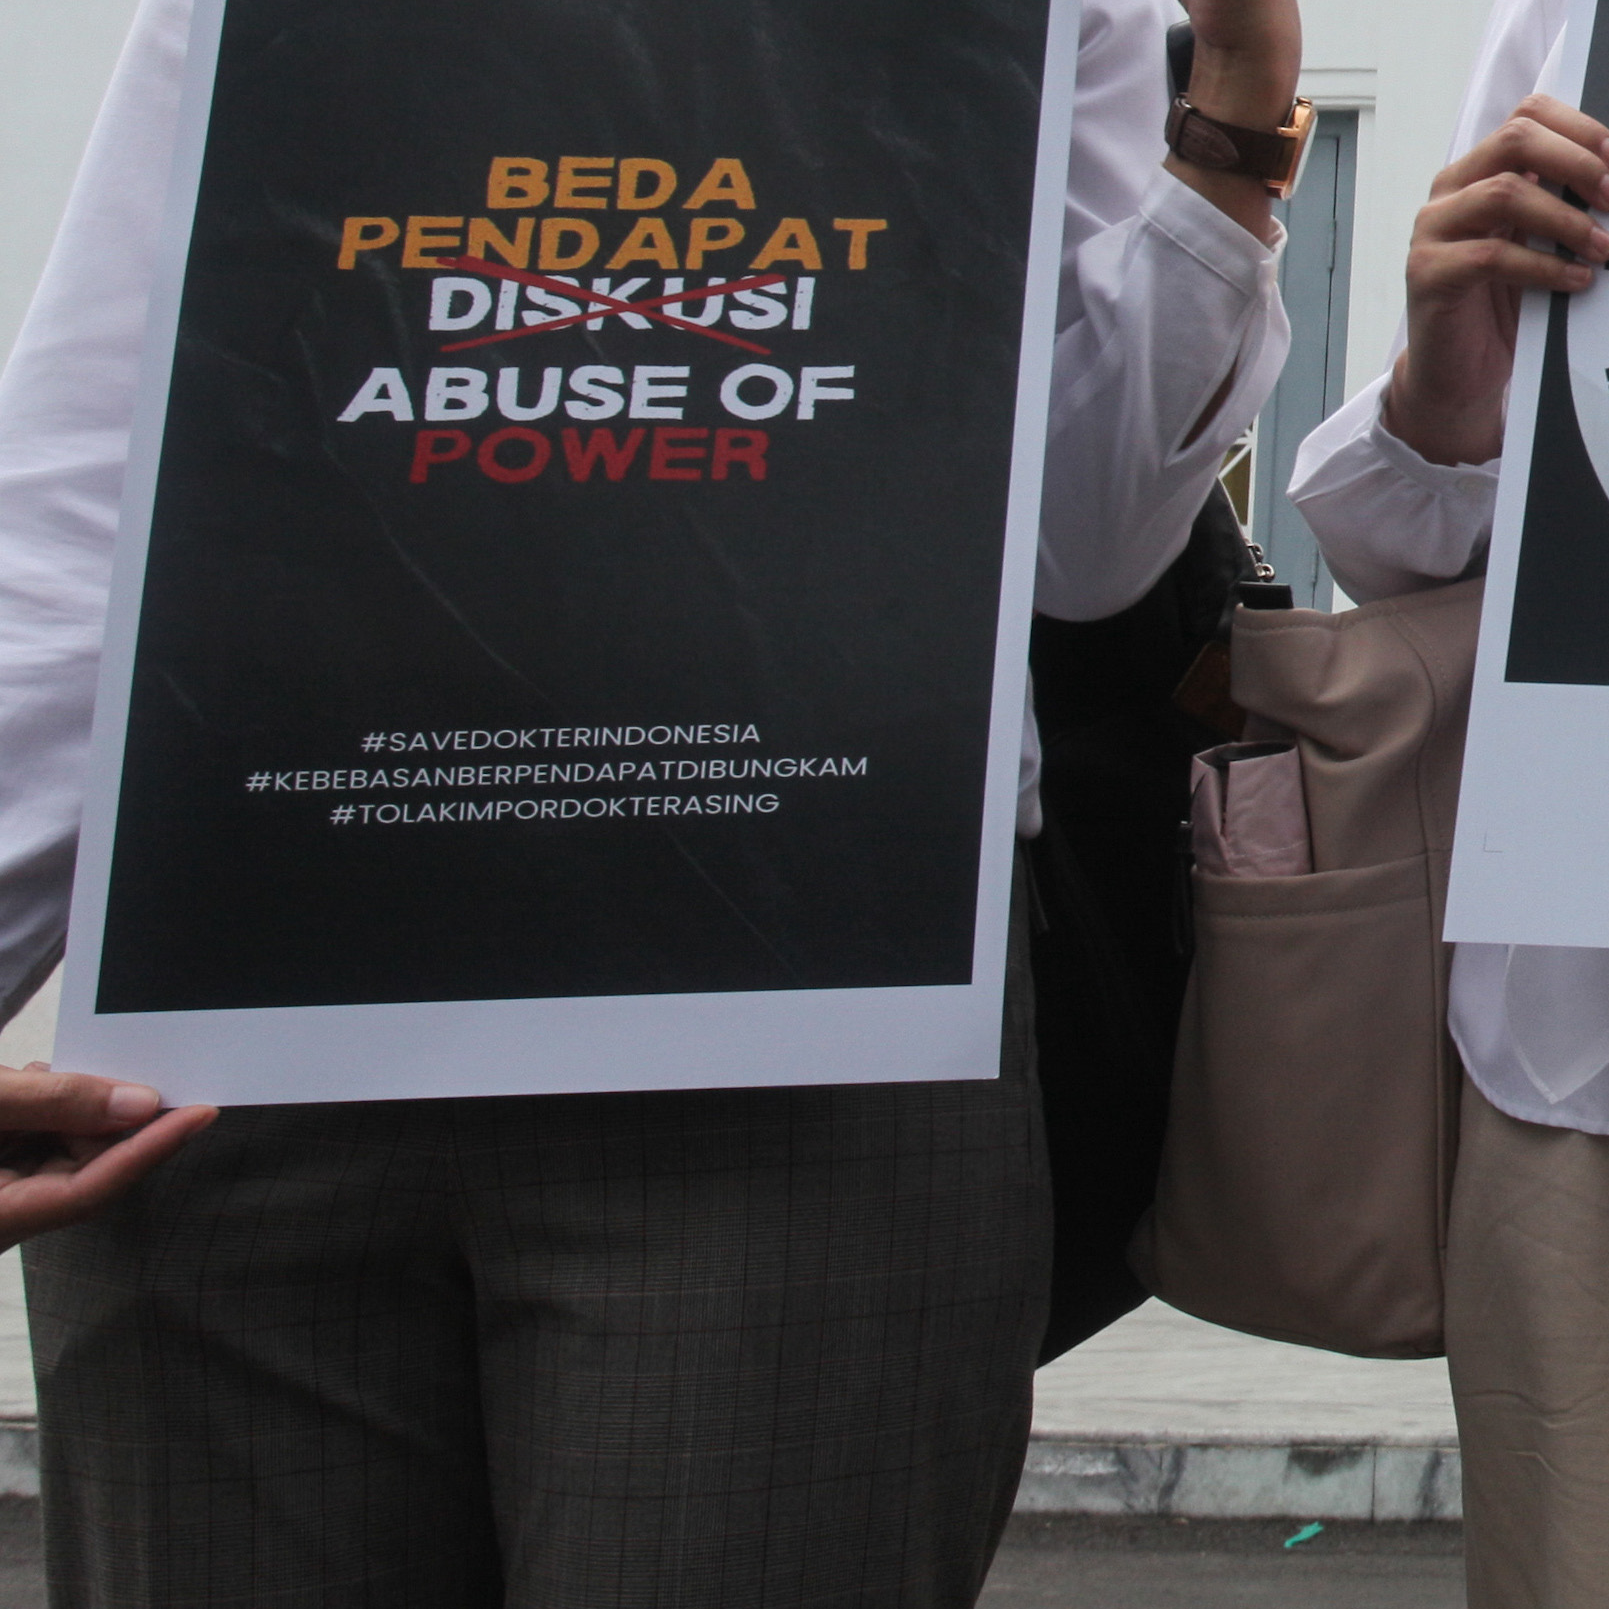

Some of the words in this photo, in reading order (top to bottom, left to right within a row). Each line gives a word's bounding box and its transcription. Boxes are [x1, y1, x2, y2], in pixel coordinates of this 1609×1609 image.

[487, 156, 756, 209] BEDA
[337, 216, 887, 270] PENDAPAT
[428, 275, 815, 331] DISKUSI
[337, 365, 690, 422] ABUSE
[719, 363, 854, 420] OF
[409, 427, 770, 483] POWER
[361, 724, 761, 752] #SAVEDOKTERINDONESIA
[245, 756, 868, 793] #KEBEBASANBERPENDAPATDIBUNGKAM
[330, 793, 779, 825] #TOLAKIMPORDOKTERASING
